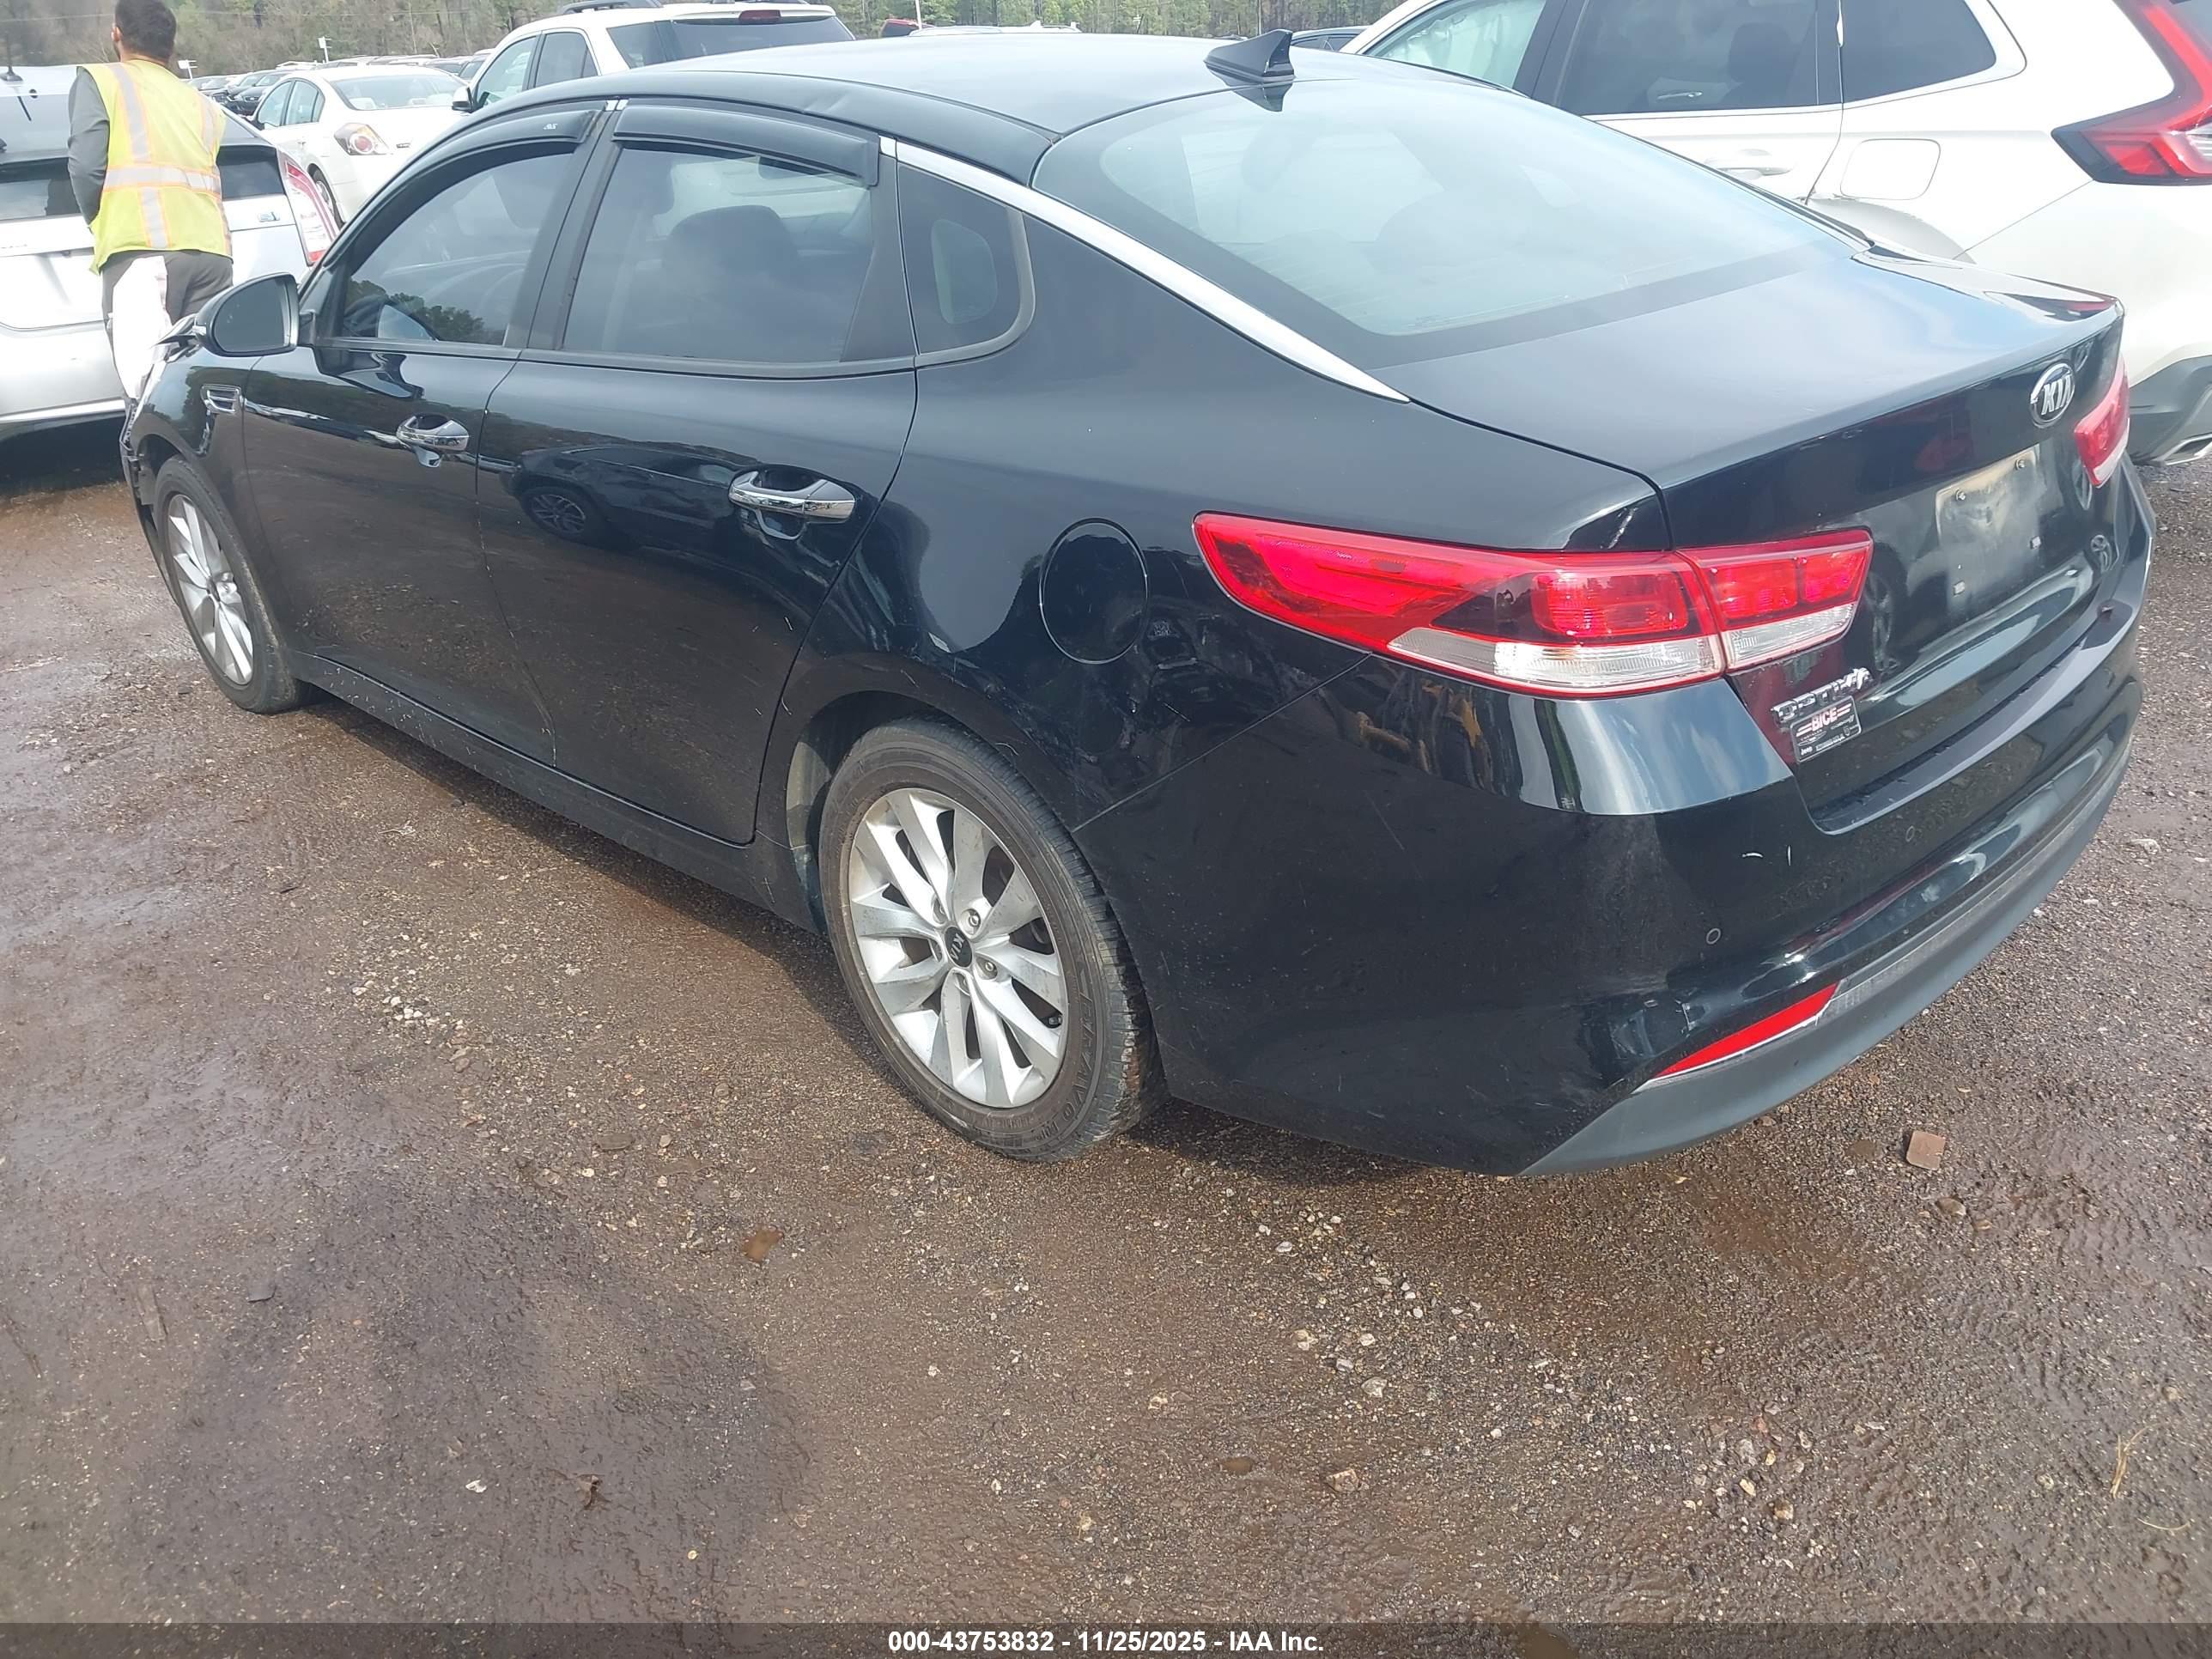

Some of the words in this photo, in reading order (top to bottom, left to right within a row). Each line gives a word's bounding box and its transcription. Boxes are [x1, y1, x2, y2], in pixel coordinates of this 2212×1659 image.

[2041, 375, 2072, 416] KIA
[1812, 707, 1838, 732] BICE
[950, 933, 964, 961] KIA
